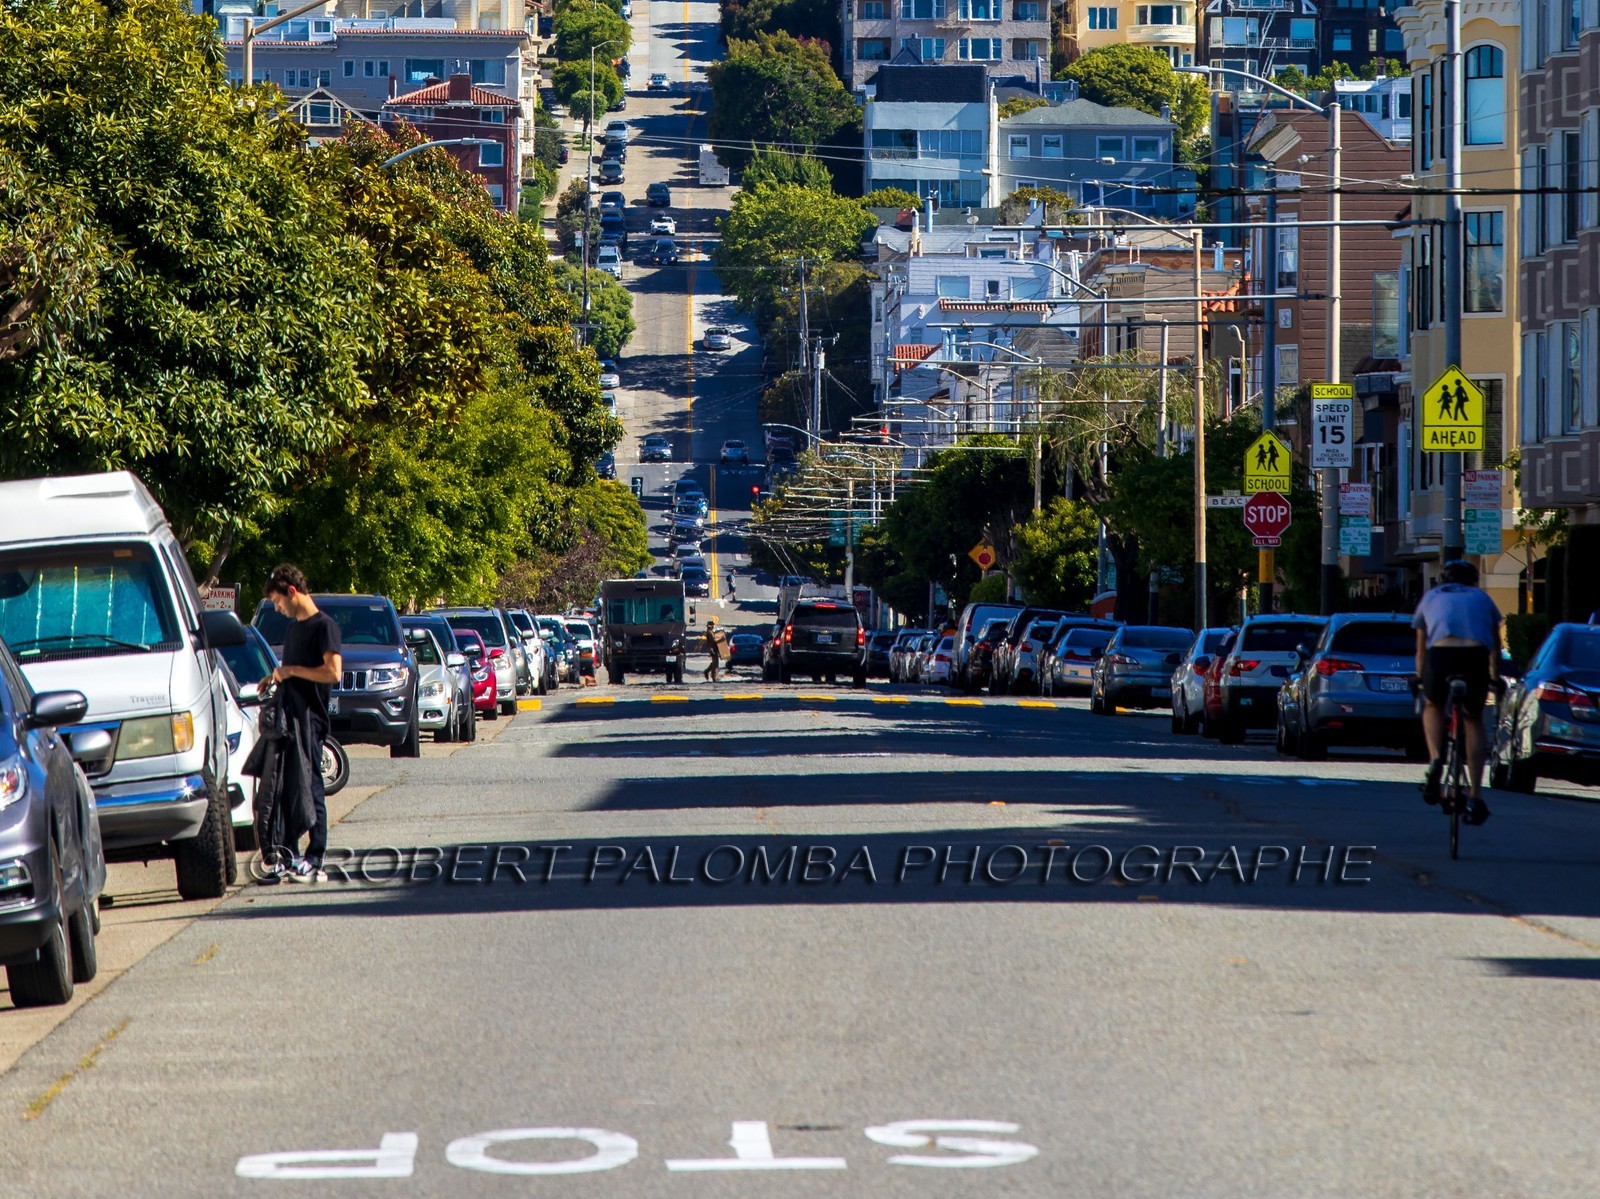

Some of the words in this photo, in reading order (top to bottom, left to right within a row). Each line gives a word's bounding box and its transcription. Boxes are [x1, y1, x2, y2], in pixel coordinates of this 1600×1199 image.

[1315, 387, 1350, 396] SCHOOL
[1315, 404, 1350, 413] SPEED
[1318, 415, 1346, 423] LIMIT
[1320, 426, 1345, 444] 15
[1431, 431, 1476, 445] AHEAD
[1465, 472, 1475, 481] NO
[1248, 479, 1288, 490] SCHOOL
[1340, 484, 1350, 493] NO
[1247, 505, 1288, 524] STOP
[210, 591, 235, 599] PARKING
[234, 1119, 1039, 1178] STOP
